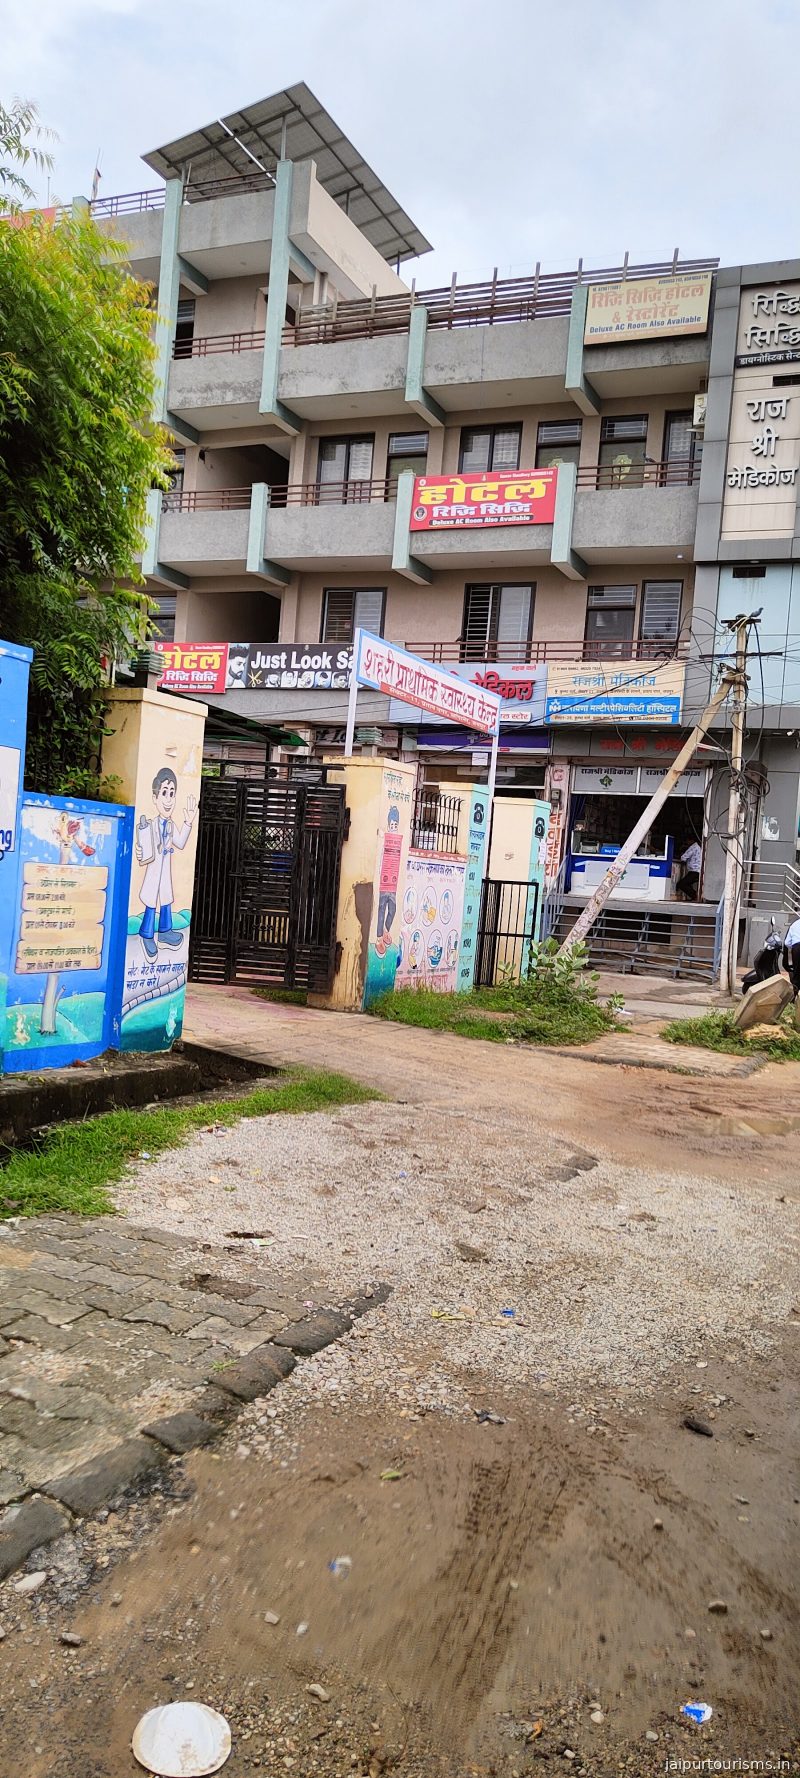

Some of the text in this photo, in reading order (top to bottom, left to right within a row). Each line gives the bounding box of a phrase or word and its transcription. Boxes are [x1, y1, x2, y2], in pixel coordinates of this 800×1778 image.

[666, 284, 706, 300] होटल
[612, 311, 621, 323] &
[650, 318, 664, 327] Also
[667, 316, 701, 325] Available
[747, 397, 791, 421] राज
[751, 425, 779, 457] श्री
[727, 463, 798, 489] मेडिकोज
[418, 478, 552, 505] होटल
[251, 651, 287, 669] Just
[291, 651, 332, 669] Look
[581, 767, 603, 775] राजश्री
